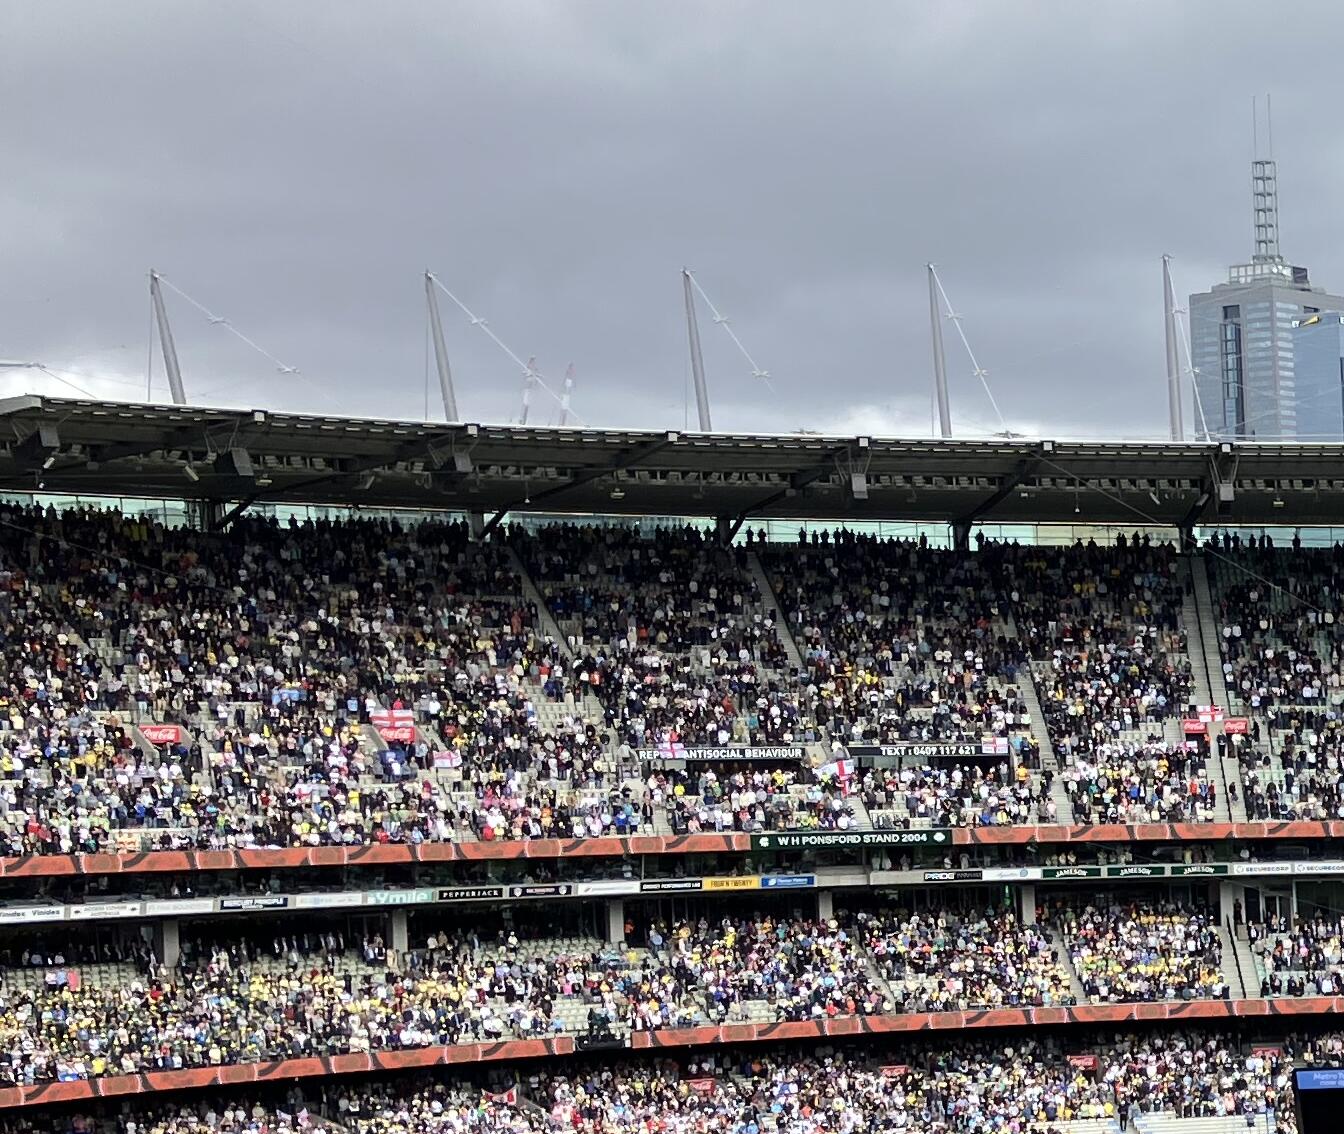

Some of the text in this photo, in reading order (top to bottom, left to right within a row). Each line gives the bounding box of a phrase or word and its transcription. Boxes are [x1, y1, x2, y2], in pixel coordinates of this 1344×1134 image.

[683, 749, 743, 759] ANTISOCIAL
[745, 748, 802, 758] BEHAVIOUR
[881, 747, 905, 756] TEXT
[913, 746, 936, 755] 0409
[939, 746, 956, 755] 117
[958, 746, 976, 755] 621
[777, 833, 928, 845] W H PONSFORD STAND 2004
[1055, 868, 1088, 878] JAMESON
[1120, 867, 1152, 876] JAMESON
[1183, 866, 1215, 874] JAMESON
[443, 890, 499, 898] PEPPERJACK
